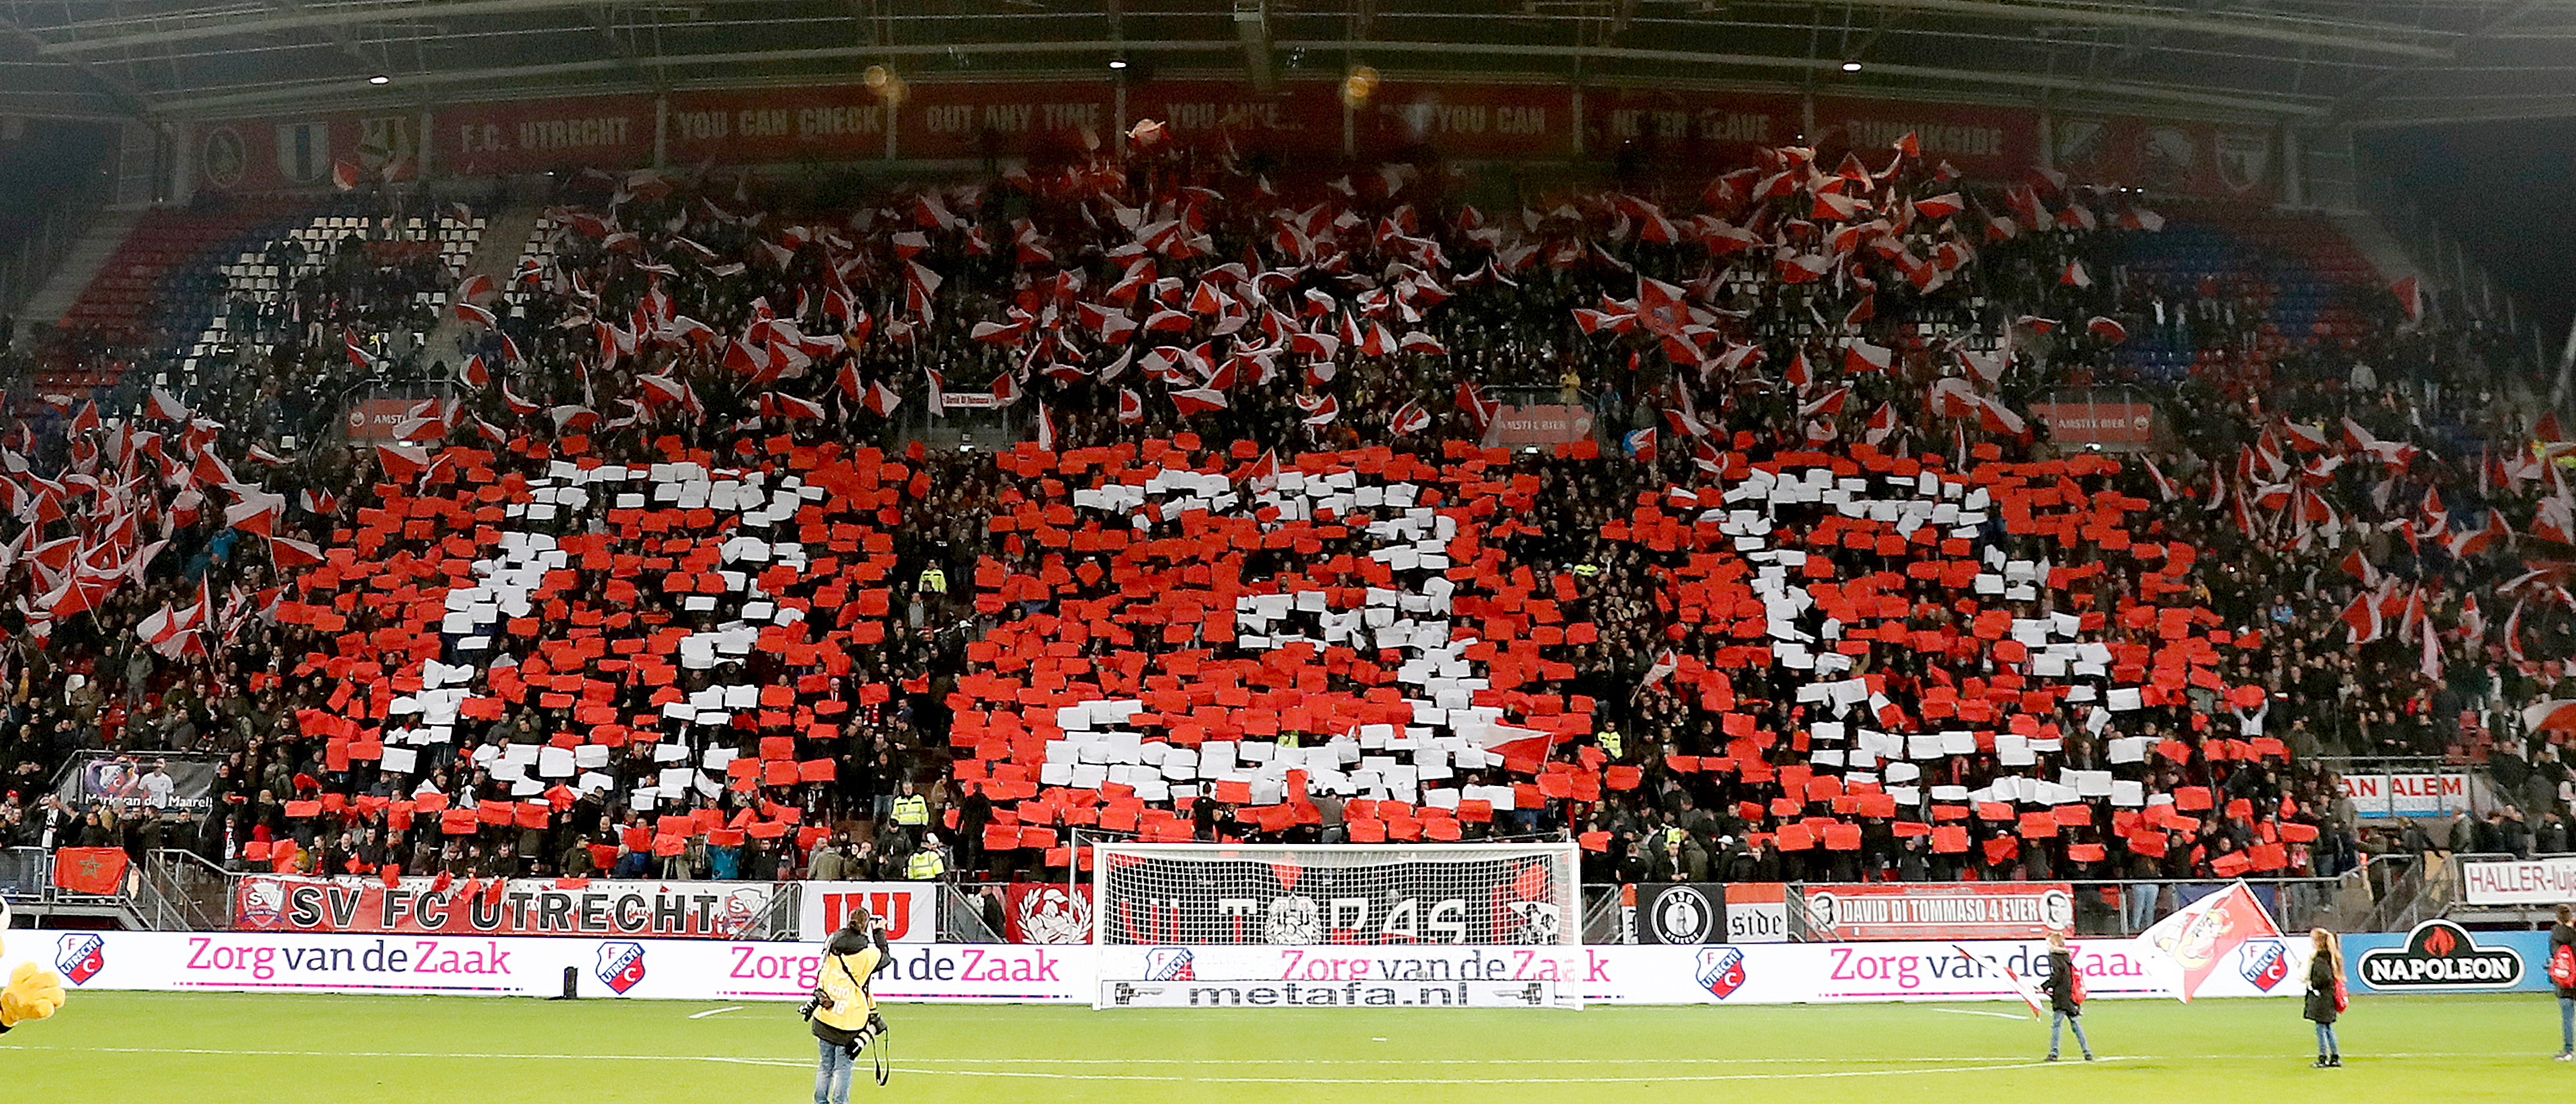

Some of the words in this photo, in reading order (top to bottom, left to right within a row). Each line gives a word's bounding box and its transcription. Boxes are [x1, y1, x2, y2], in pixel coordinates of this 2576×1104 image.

[679, 110, 728, 141] YOU
[738, 109, 788, 137] CAN
[798, 105, 881, 139] CHECK
[926, 104, 975, 133] OUT
[984, 104, 1033, 132] ANY
[1165, 102, 1216, 131] YOU
[1435, 105, 1487, 134] YOU
[1496, 105, 1546, 135] CAN
[1612, 109, 1688, 138] NEER
[461, 123, 509, 154] F.C.
[519, 117, 629, 148] UTRECHT
[168, 795, 213, 808] Maarel!
[2391, 778, 2462, 796] ALEM
[2469, 865, 2576, 897] HALLER-luj
[289, 886, 366, 929] SV
[380, 889, 449, 931] FC
[469, 890, 719, 933] UTRECHT
[1668, 891, 1694, 904] 030
[1842, 899, 1888, 922] DAVID
[1892, 899, 1908, 922] DI
[1910, 898, 1986, 922] TOMMASO
[1989, 899, 1999, 922] 4
[2004, 898, 2039, 922] EVER
[60, 935, 101, 974] UTRECHT
[83, 958, 96, 973] C
[186, 937, 276, 980] Zorg
[282, 948, 355, 972] van
[362, 940, 408, 972] de
[414, 940, 511, 974] Zaak
[601, 944, 643, 984] UTRECHT
[730, 946, 819, 989] Zorg
[909, 948, 954, 981] de
[961, 949, 1060, 982] Zaak
[1281, 949, 1371, 980] Zorg
[1378, 958, 1450, 981] van
[1460, 949, 1506, 981] de
[1702, 949, 1742, 988] UTRECHT
[1831, 948, 1920, 989] Zorg
[2008, 945, 2052, 978] de
[2369, 957, 2512, 981] NAPOLEON
[624, 967, 637, 981] C
[1725, 972, 1738, 986] C
[2267, 965, 2280, 980] C
[1189, 982, 1468, 1006] metafa.nl
